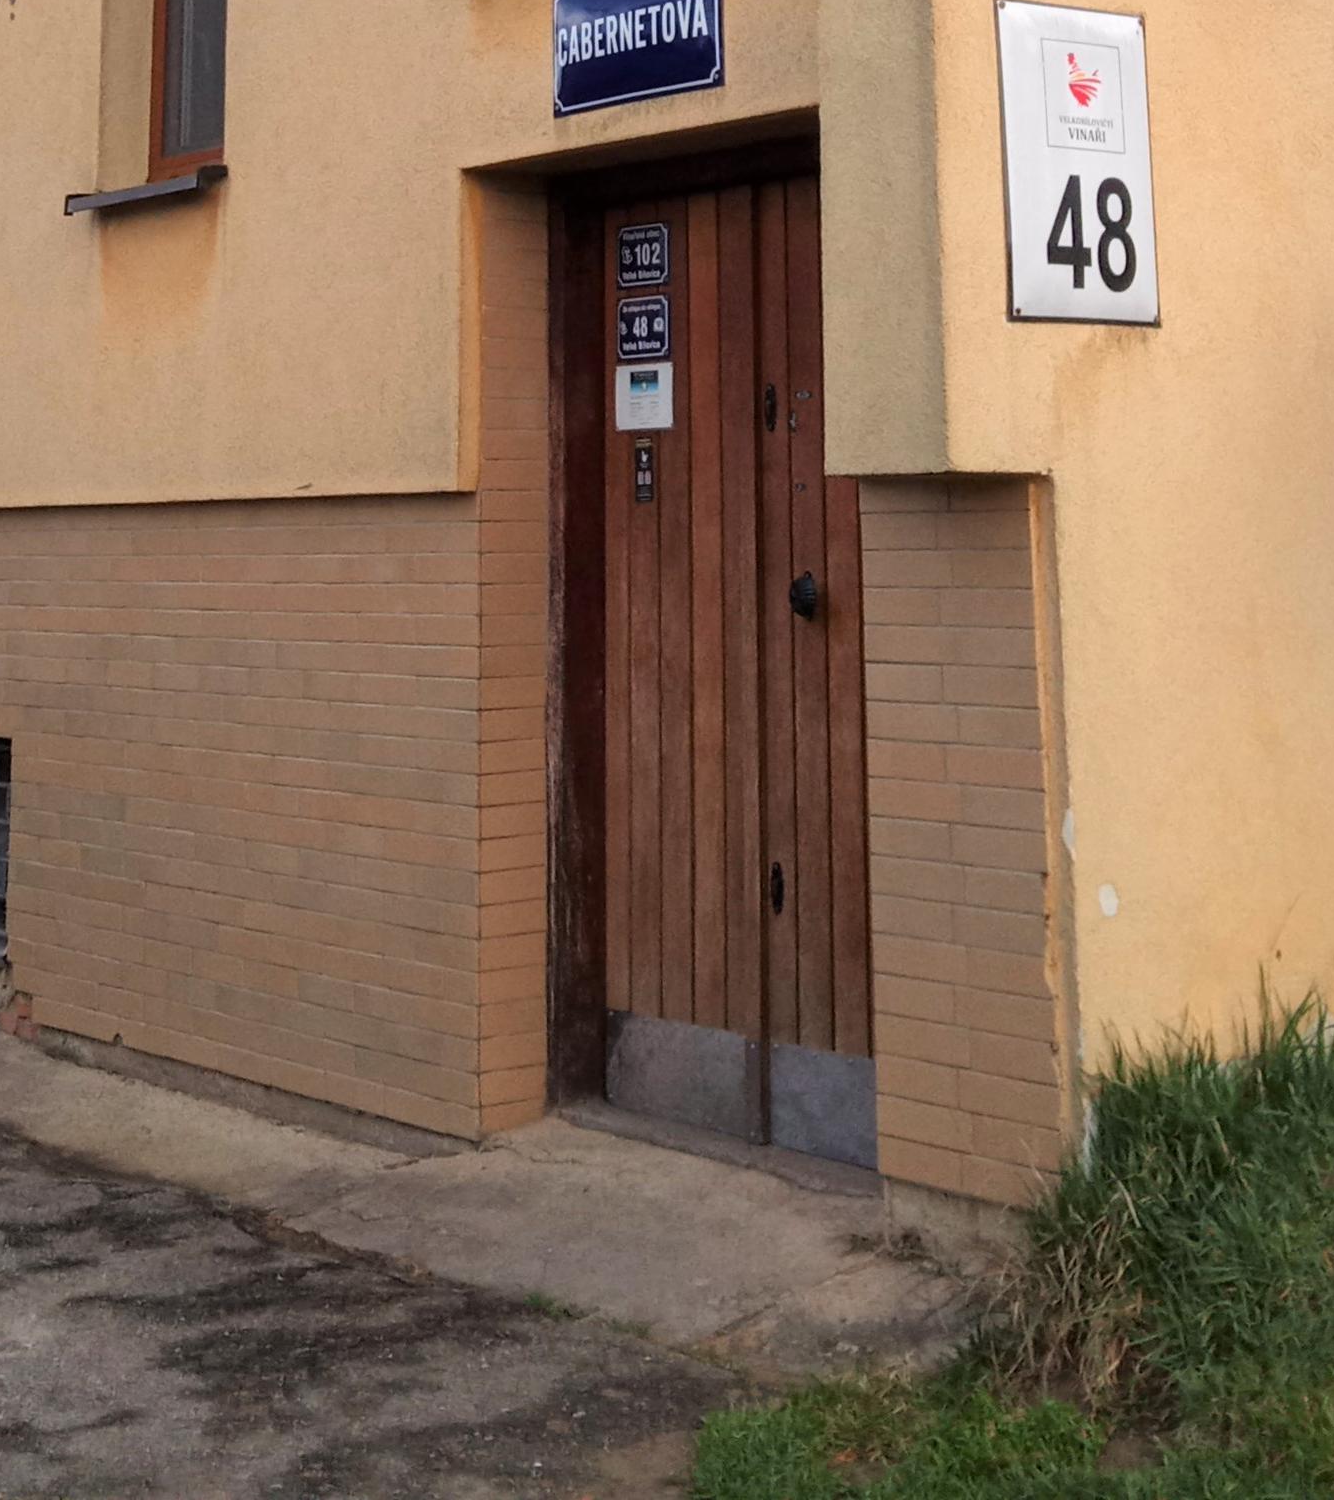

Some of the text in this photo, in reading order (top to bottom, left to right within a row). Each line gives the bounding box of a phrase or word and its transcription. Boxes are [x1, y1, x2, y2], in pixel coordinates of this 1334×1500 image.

[1046, 174, 1137, 293] 48
[633, 242, 661, 266] 102
[632, 315, 648, 338] 48
